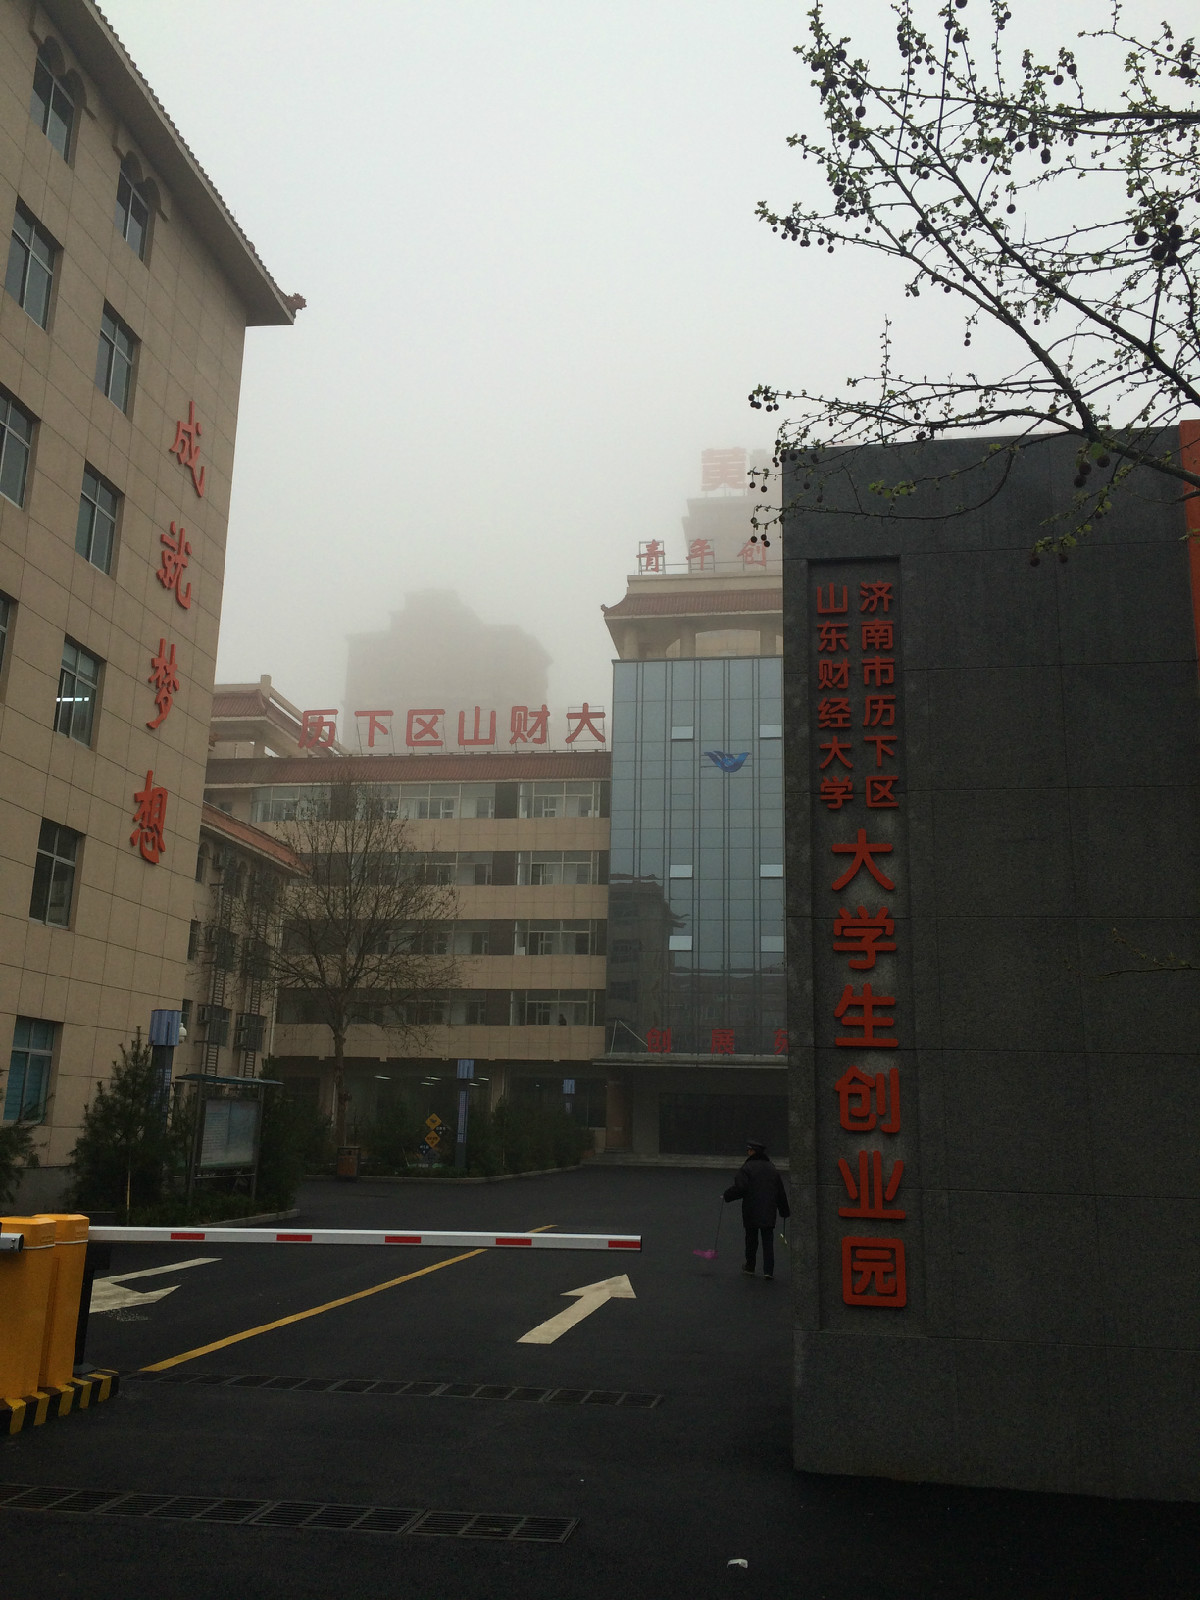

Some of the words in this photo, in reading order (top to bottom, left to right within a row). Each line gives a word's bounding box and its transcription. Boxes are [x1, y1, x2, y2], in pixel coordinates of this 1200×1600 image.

[130, 401, 206, 864] 成就梦想
[636, 538, 767, 573] 青年创
[297, 702, 606, 749] 历下区山财大
[816, 582, 854, 810] 山东财经大学
[859, 580, 900, 808] 济南市历下区
[831, 828, 907, 1308] 大学生创业园
